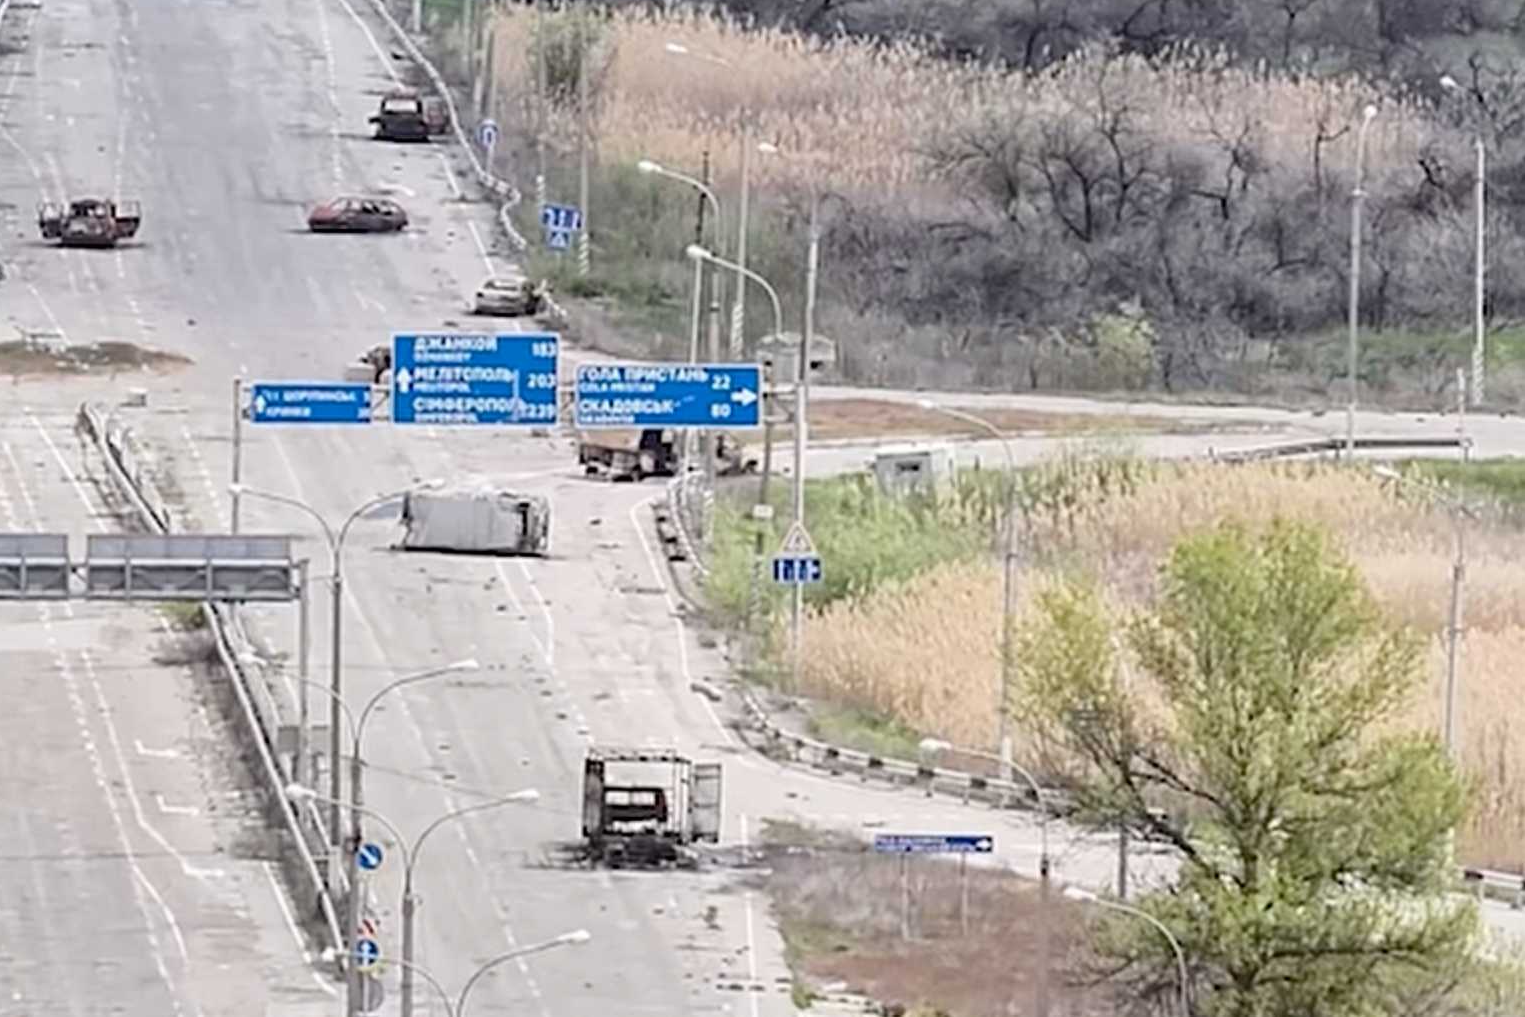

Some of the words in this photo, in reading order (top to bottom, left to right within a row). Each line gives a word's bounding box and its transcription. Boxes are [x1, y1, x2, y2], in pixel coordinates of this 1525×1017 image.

[414, 337, 497, 352] ДЖАНКОЙ
[532, 342, 556, 358] 183
[413, 367, 513, 382] МЕЛІТОПОЛЬ
[527, 373, 556, 388] 203
[580, 367, 620, 380] ГОЛА
[625, 367, 709, 382] ПРИСТАНЬ
[711, 374, 731, 390] 22
[580, 399, 674, 414] СКАДОВСЬК
[711, 403, 731, 418] 80
